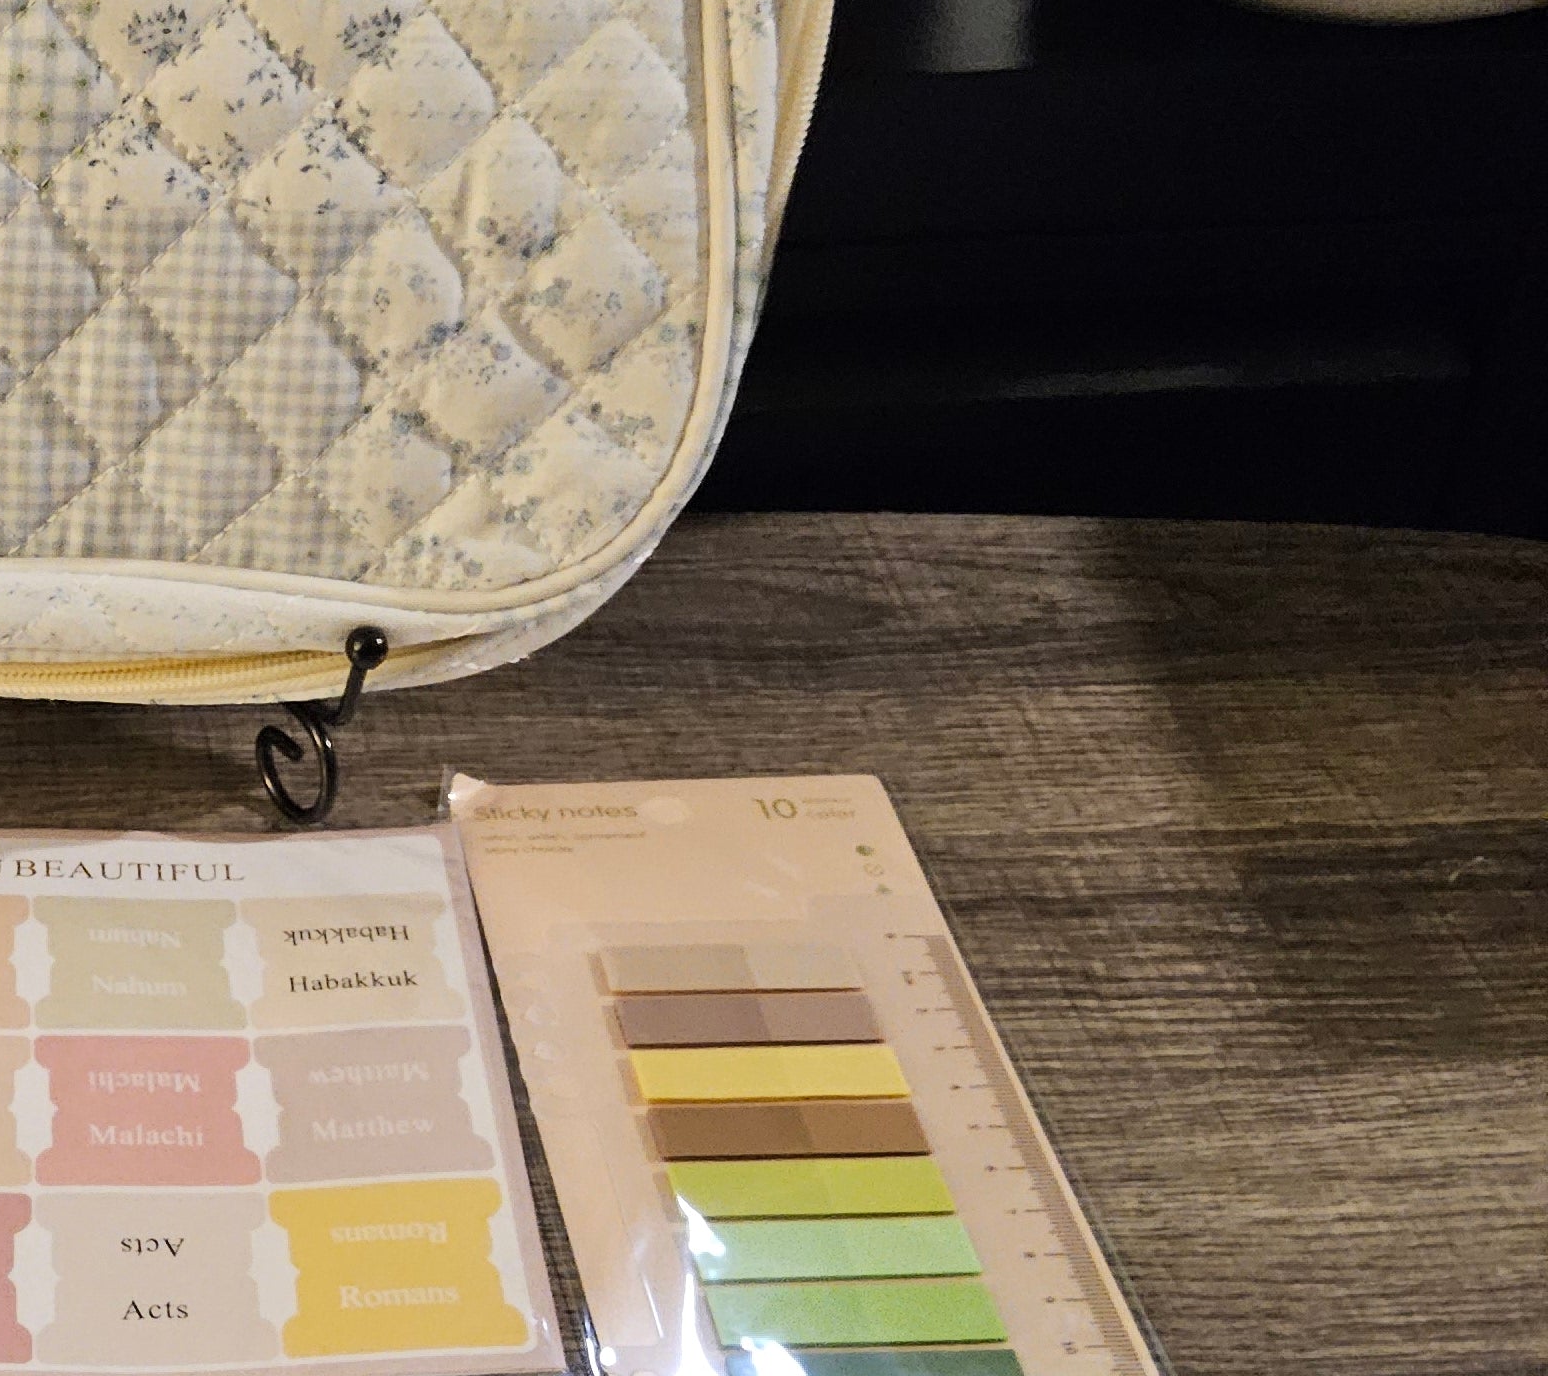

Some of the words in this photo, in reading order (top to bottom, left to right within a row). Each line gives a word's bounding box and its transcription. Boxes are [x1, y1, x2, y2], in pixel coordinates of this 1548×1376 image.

[559, 805, 638, 819] notes
[754, 797, 798, 820] 10
[14, 859, 245, 882] BEAUTIFUL
[283, 925, 411, 947] Habakkuk
[288, 970, 419, 993] Habakkuk
[89, 1123, 205, 1147] Malachi
[312, 1115, 435, 1141] Matthew
[121, 1237, 185, 1258] Acts
[339, 1285, 459, 1309] Romans
[122, 1297, 189, 1321] Acts
